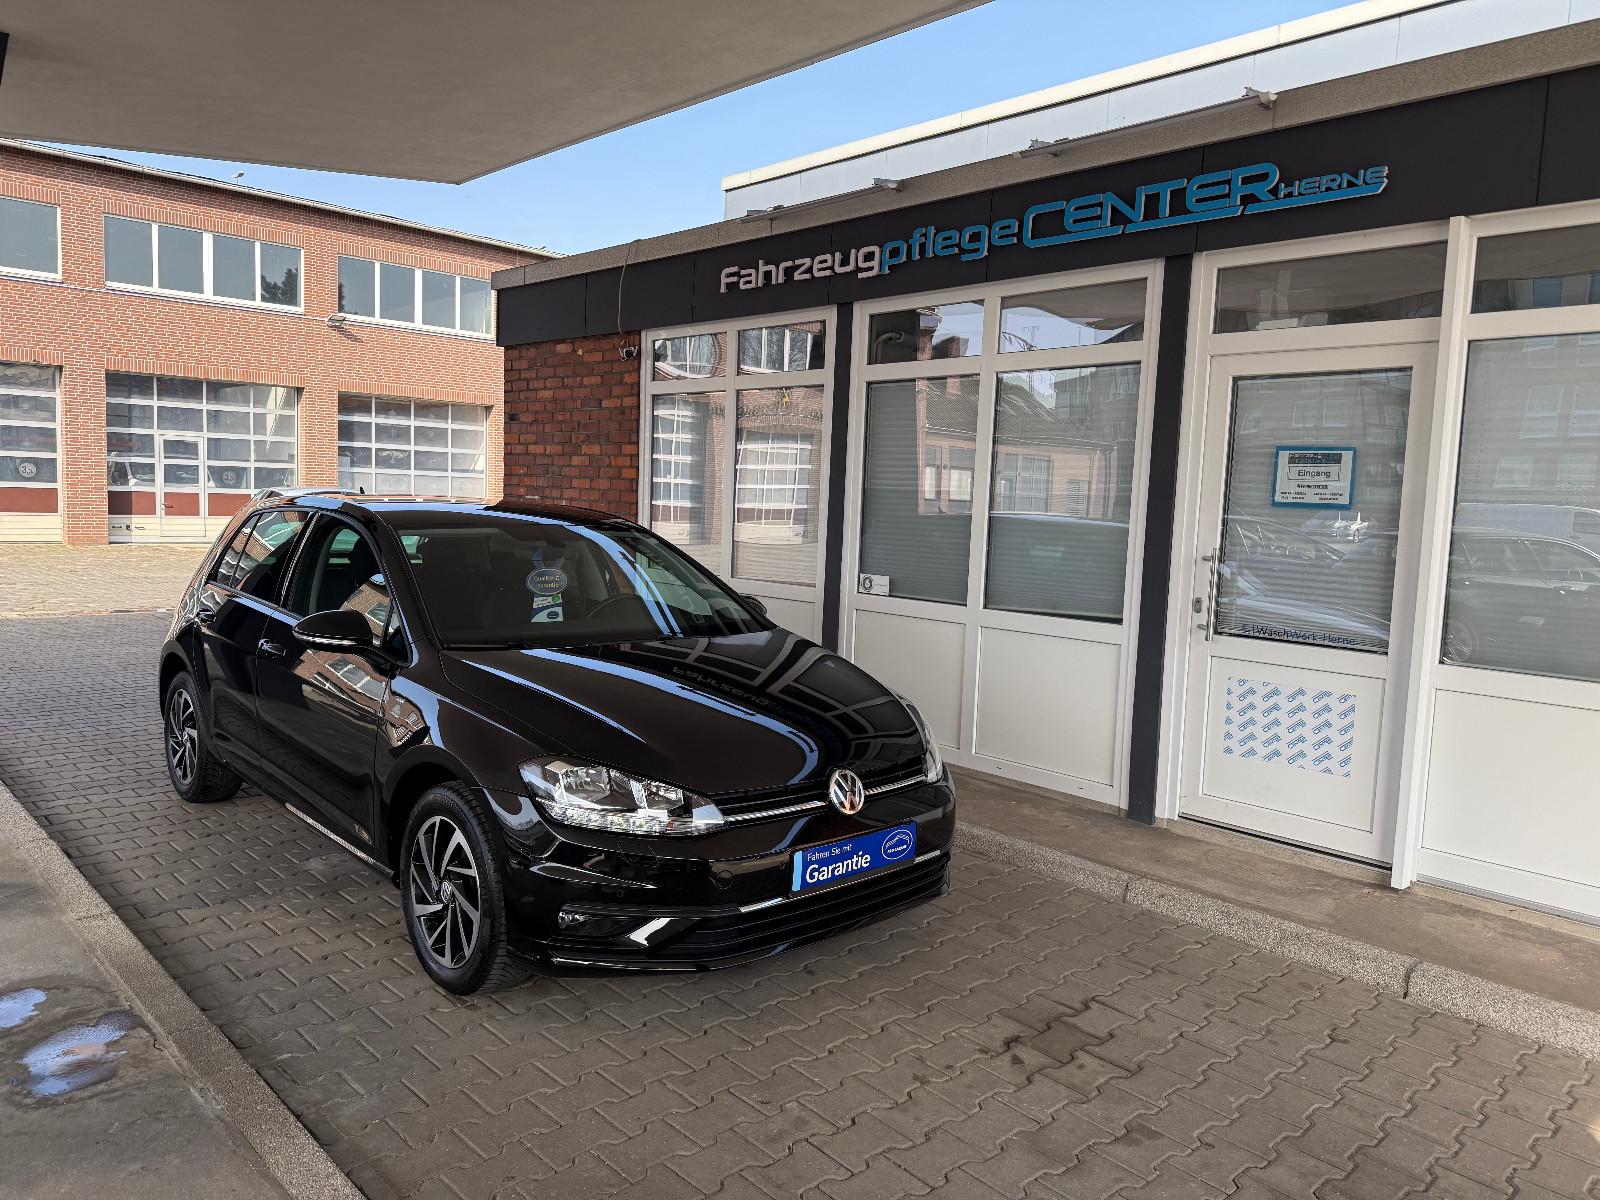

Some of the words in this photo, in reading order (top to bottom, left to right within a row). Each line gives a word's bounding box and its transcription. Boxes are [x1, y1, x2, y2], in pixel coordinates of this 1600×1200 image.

[1278, 165, 1388, 198] HERNE
[1297, 469, 1331, 478] Eingang
[807, 851, 829, 861] Fahren
[832, 845, 841, 856] Sie
[842, 844, 852, 853] mit
[805, 851, 871, 884] Garantie
